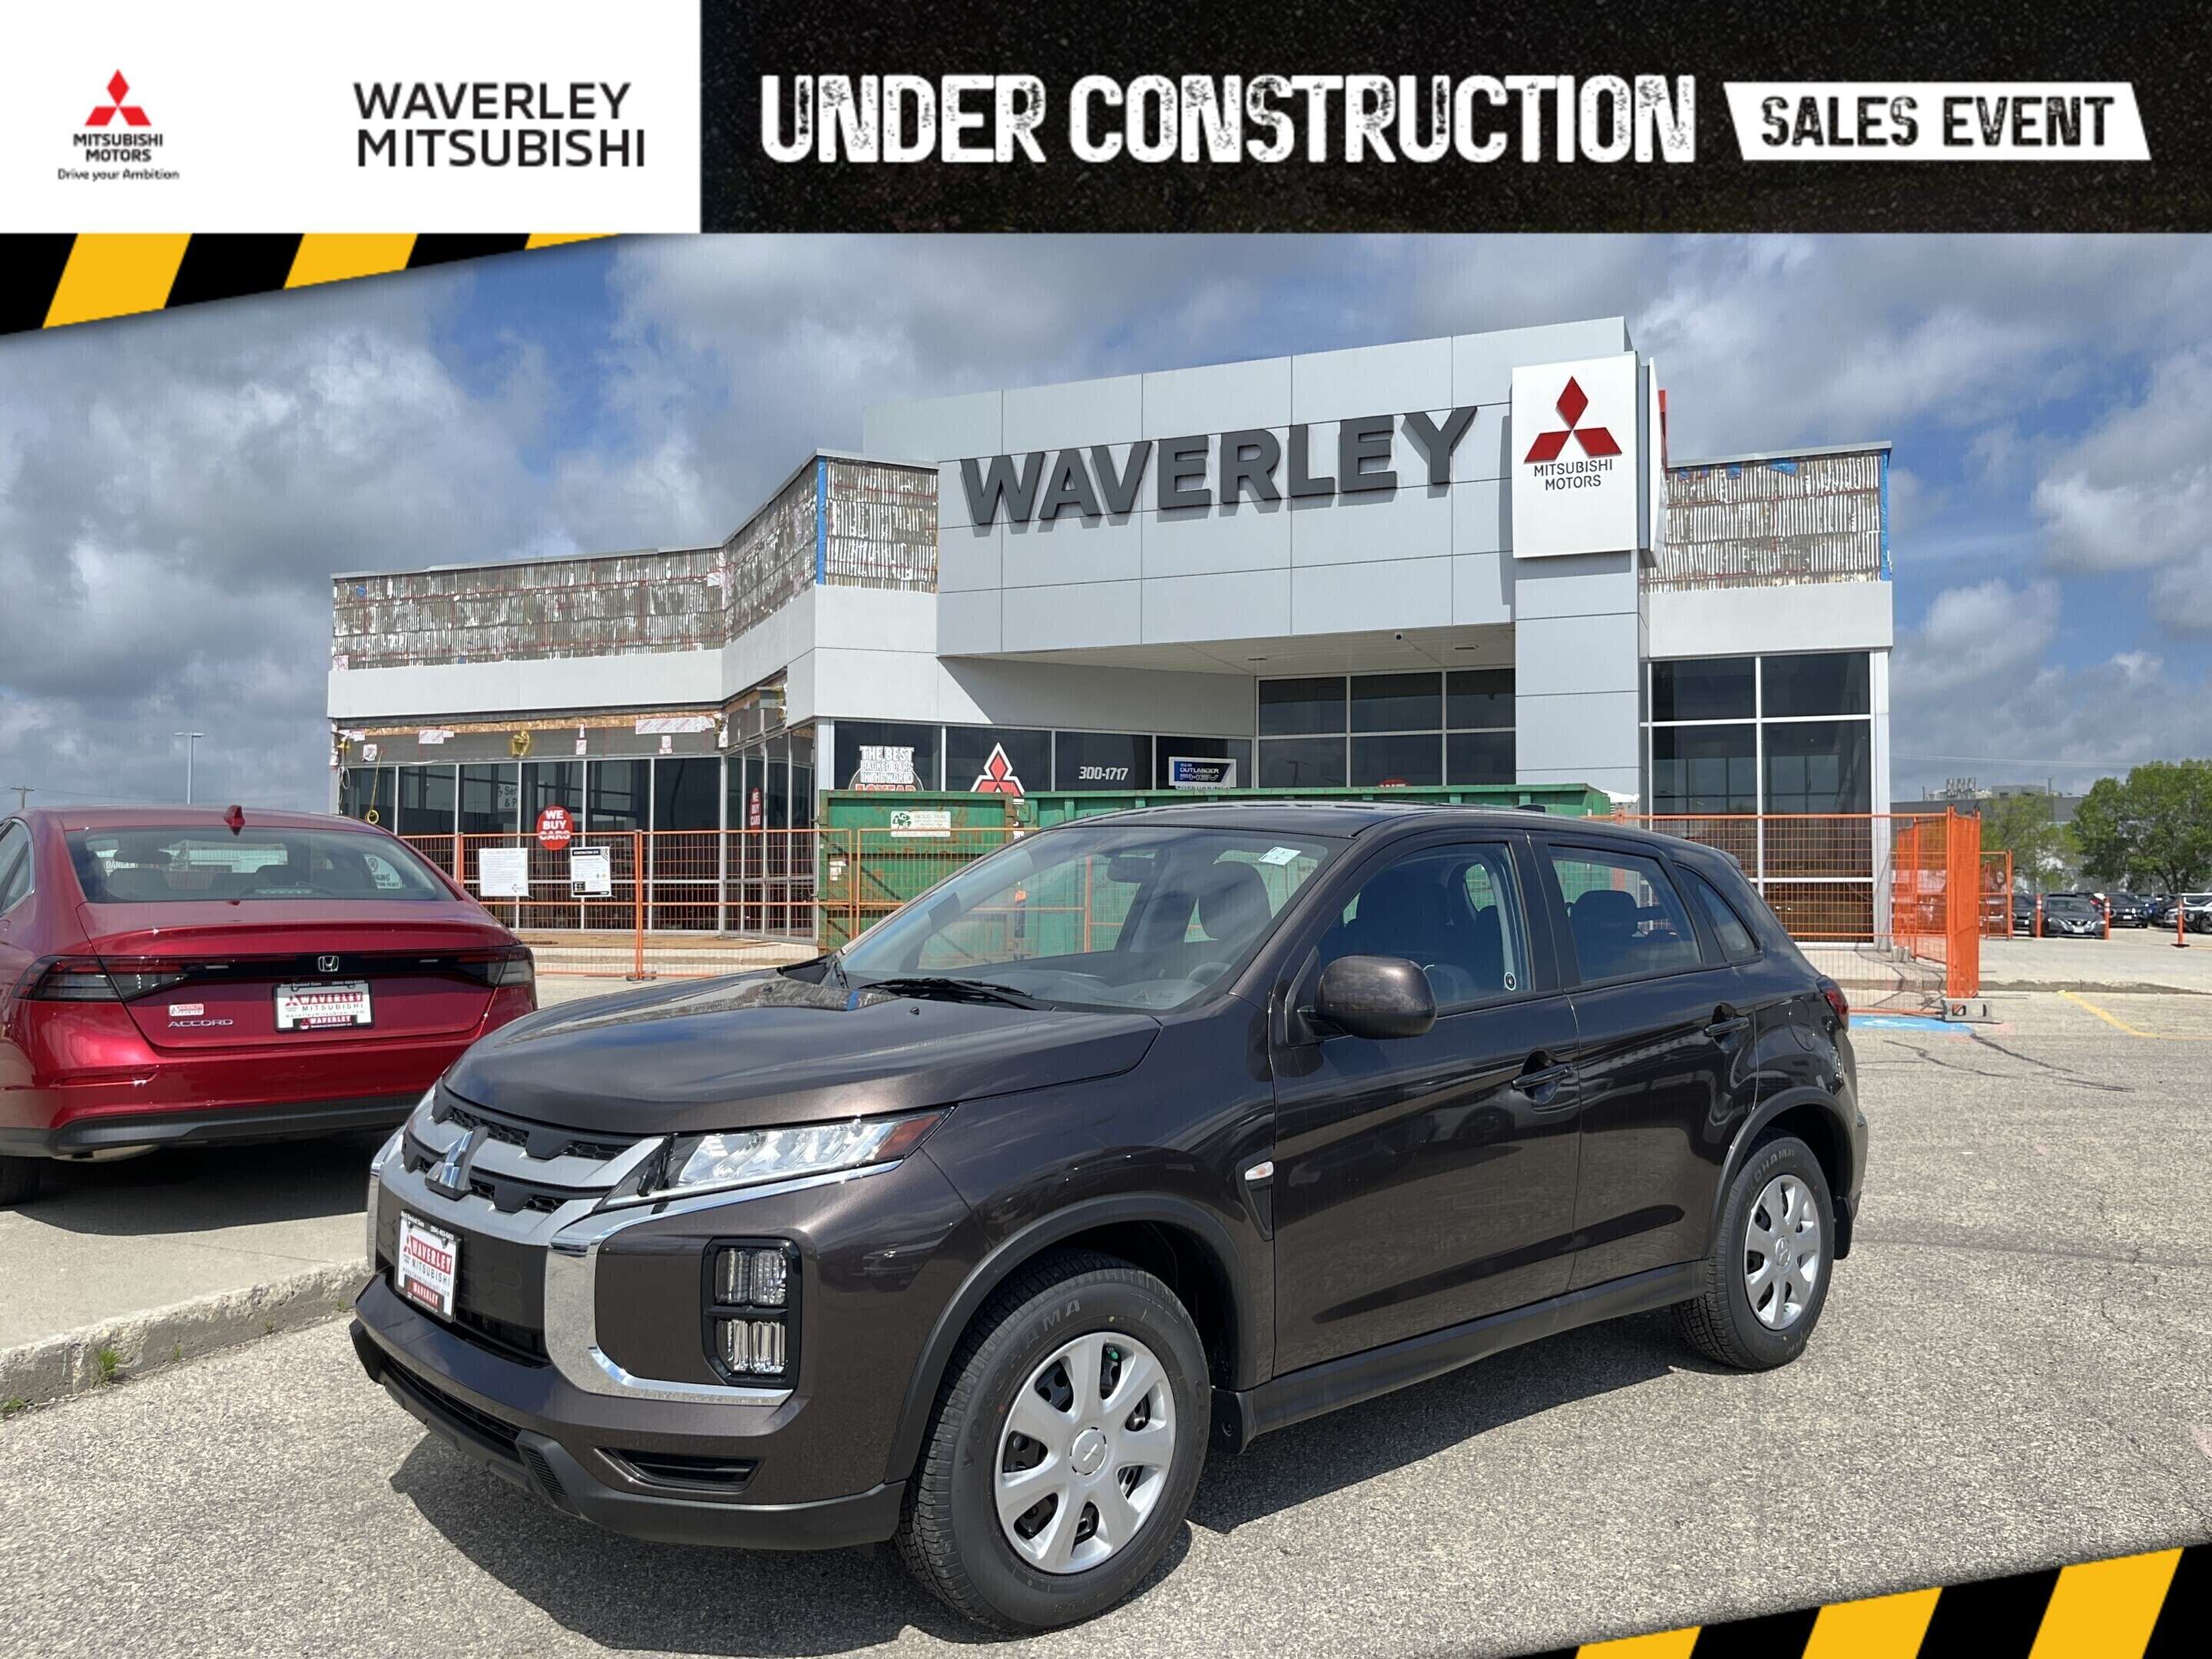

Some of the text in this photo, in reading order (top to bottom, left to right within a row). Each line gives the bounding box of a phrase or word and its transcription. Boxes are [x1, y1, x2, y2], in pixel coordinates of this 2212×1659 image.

[961, 406, 1478, 525] WAVERLEY
[1534, 459, 1613, 477] MITSUBISHI
[1545, 474, 1601, 491] MOTORS
[859, 746, 915, 761] THE BEST
[861, 761, 913, 772] BACKED CARS
[861, 773, 913, 783] IN THE WORLD
[1078, 766, 1128, 780] 300-1717
[545, 810, 565, 820] WE
[542, 820, 568, 830] BUY
[538, 830, 571, 840] CARS
[300, 993, 363, 1004] WAVERLEY
[167, 1019, 233, 1028] ACCORD
[310, 1015, 351, 1024] WAVERLEY
[412, 1237, 452, 1275] WAVERLEY
[412, 1258, 450, 1286] MITSUBISHI
[412, 1281, 439, 1306] WAVERLEY
